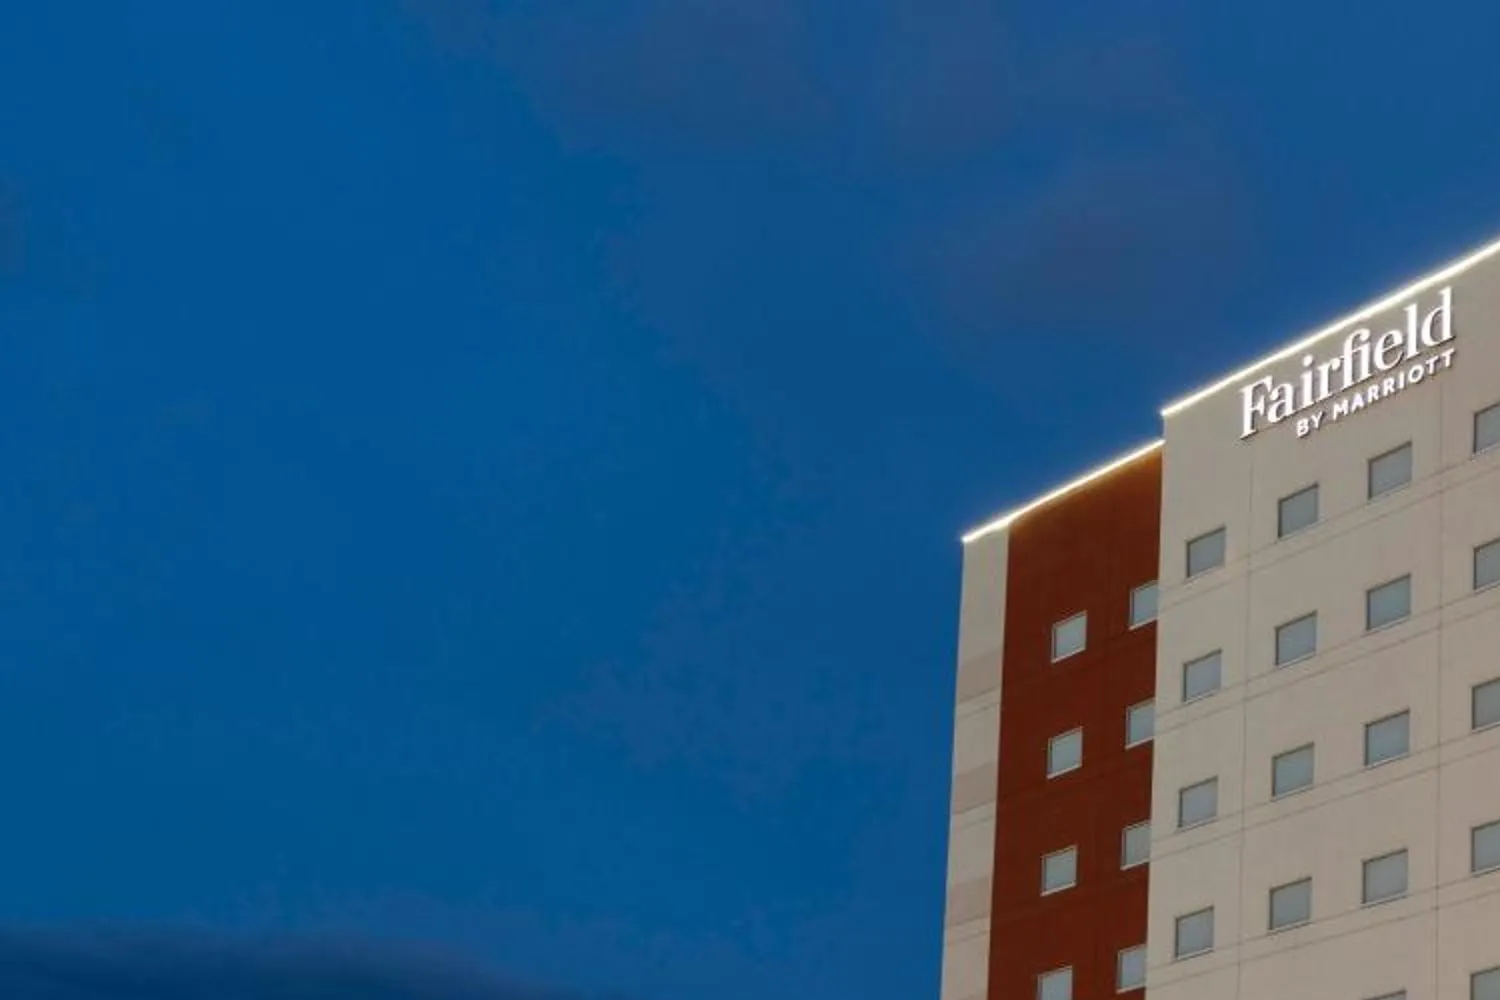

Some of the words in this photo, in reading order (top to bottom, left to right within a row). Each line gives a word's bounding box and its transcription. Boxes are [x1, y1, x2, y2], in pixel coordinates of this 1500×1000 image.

[1240, 286, 1455, 439] Fairfield
[1296, 411, 1323, 438] BY
[1333, 348, 1455, 420] MARRIOTT
